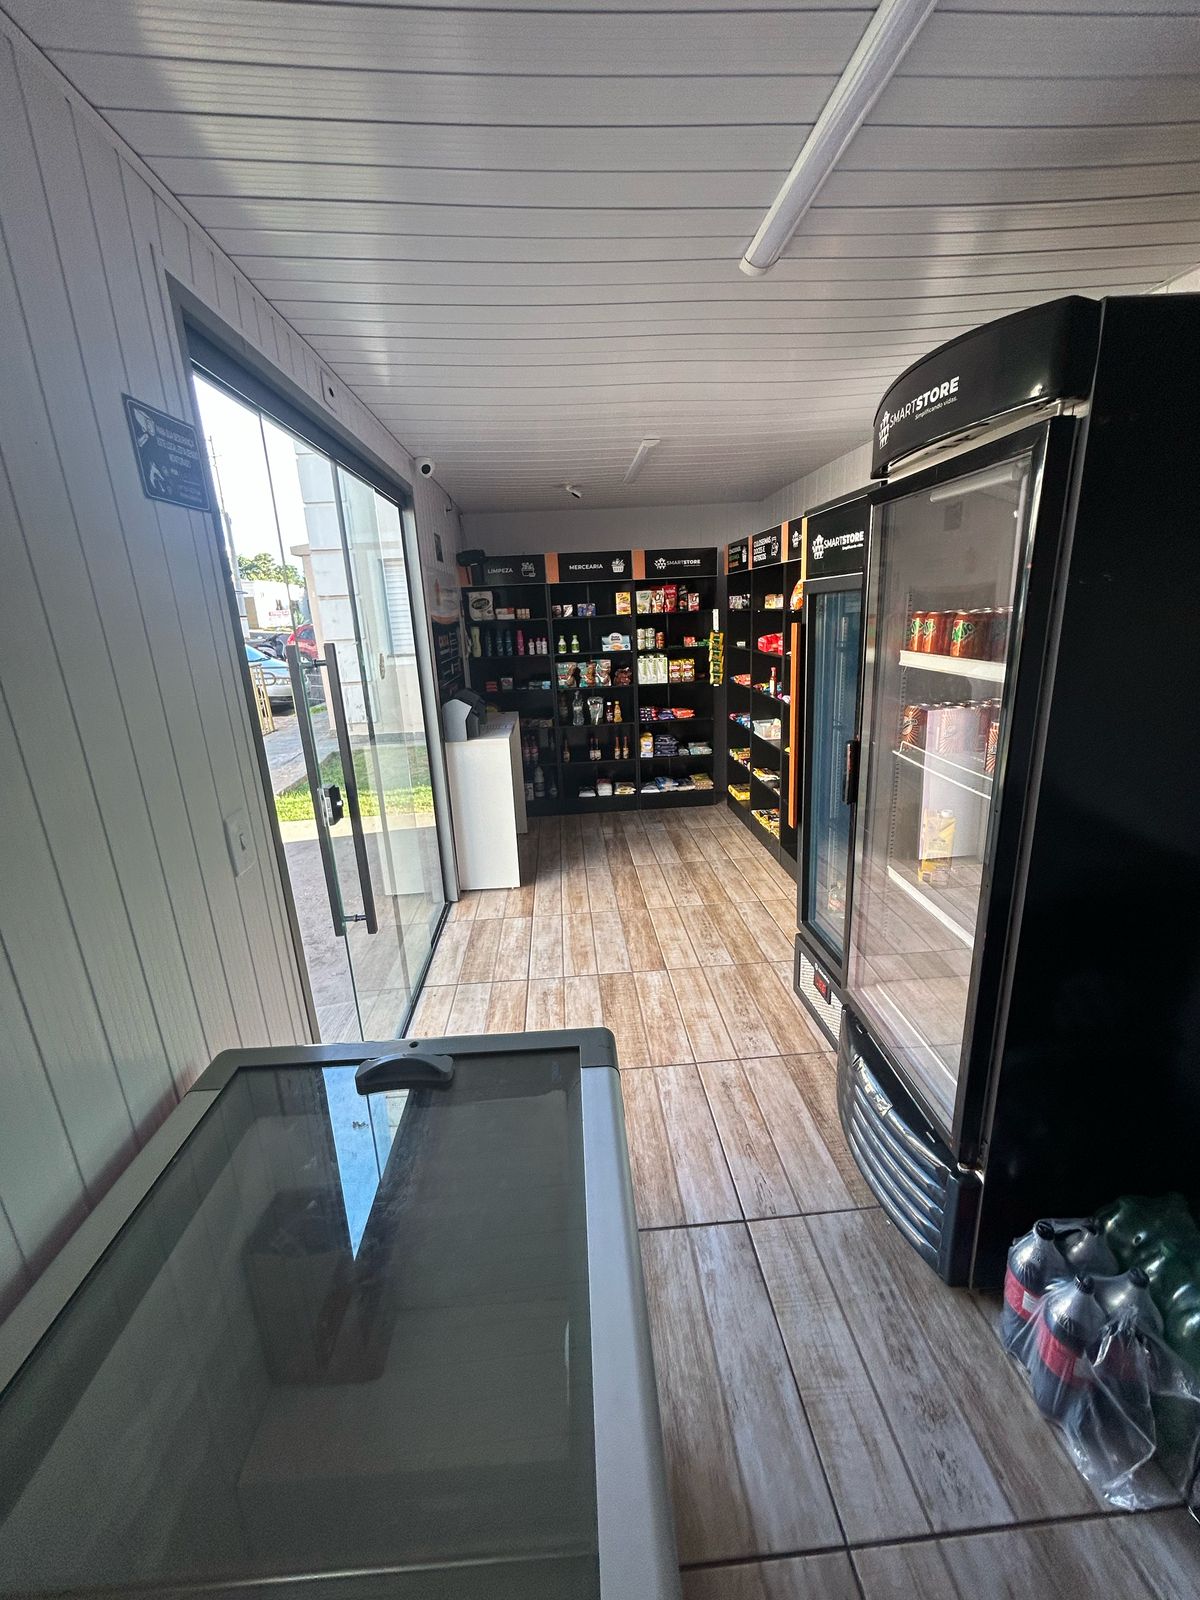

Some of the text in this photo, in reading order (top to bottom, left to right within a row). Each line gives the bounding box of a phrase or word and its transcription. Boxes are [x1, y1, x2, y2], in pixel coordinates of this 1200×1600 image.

[890, 376, 959, 428] SMARTSTORE
[824, 531, 864, 549] SMARTSTORE
[569, 563, 603, 571] MERCEARIA
